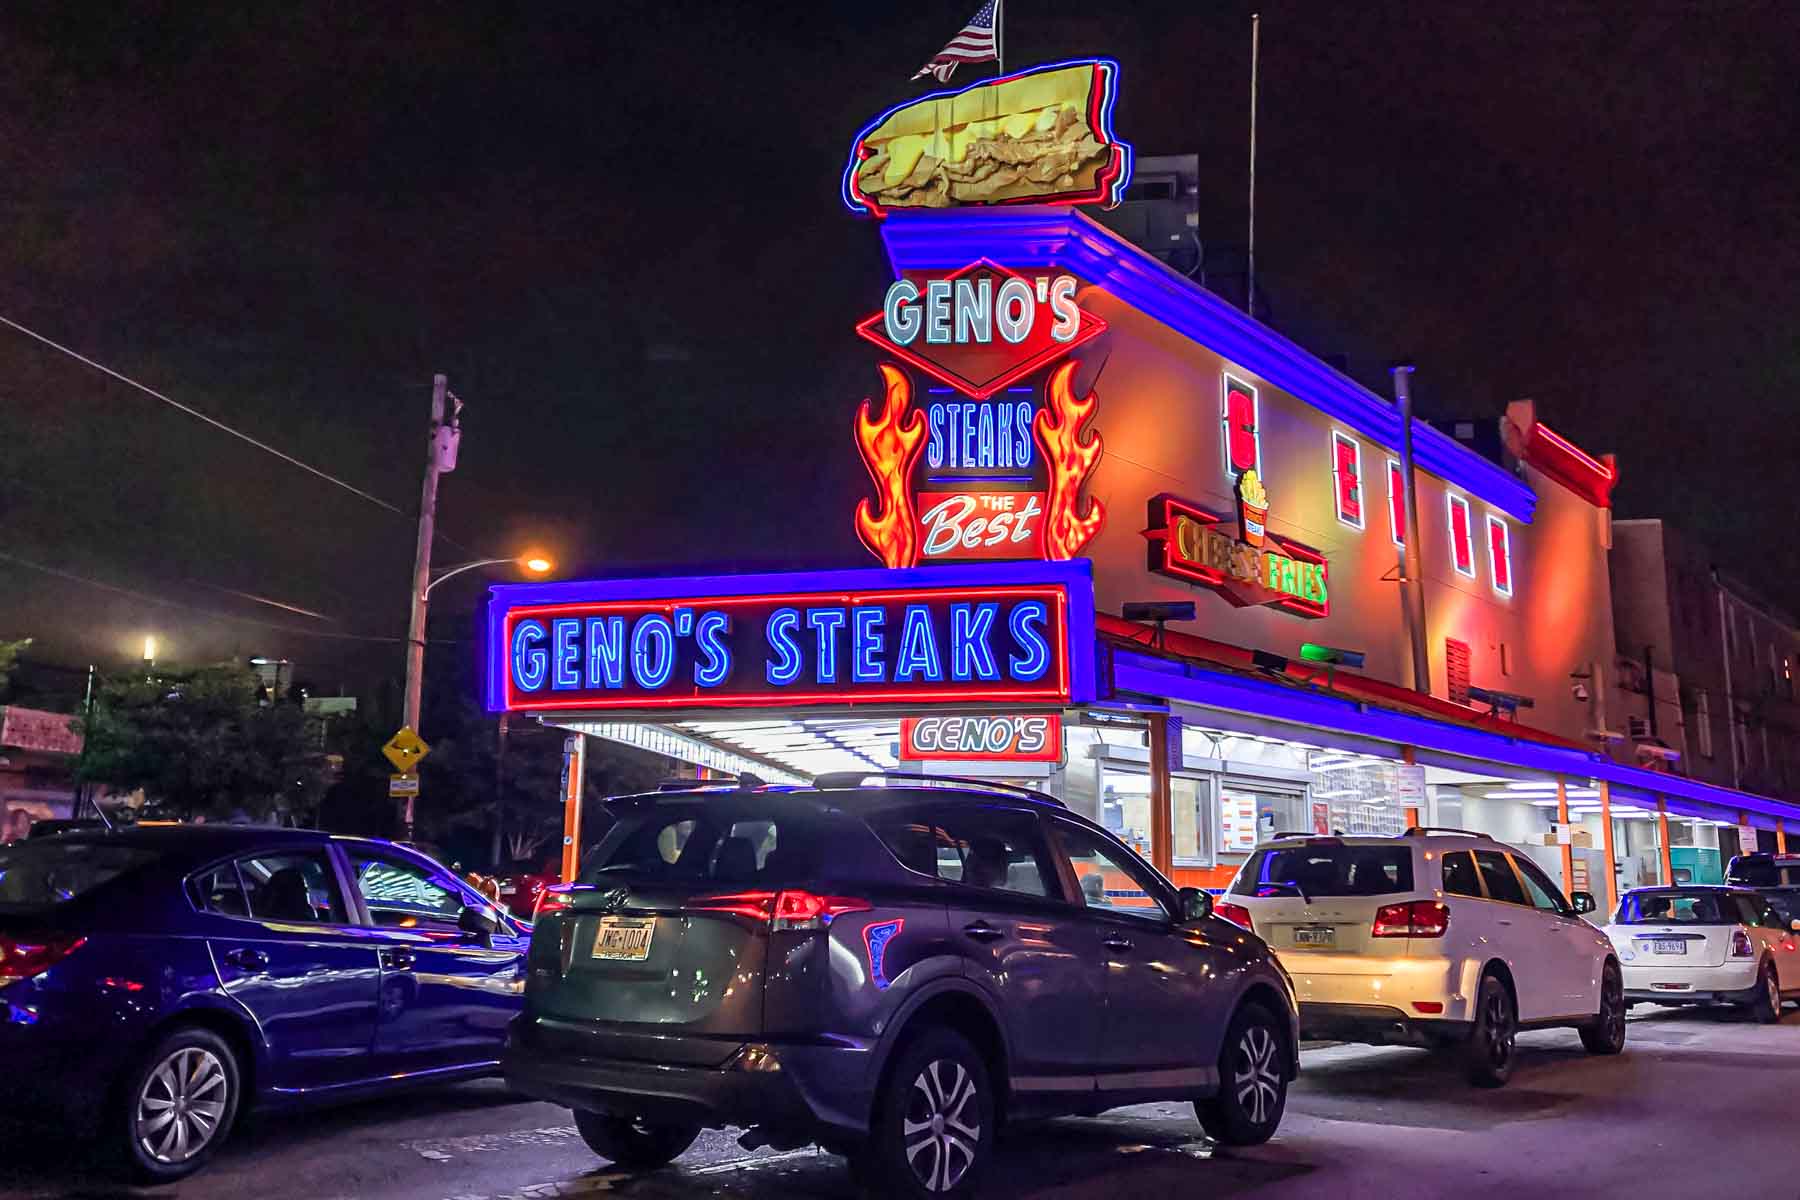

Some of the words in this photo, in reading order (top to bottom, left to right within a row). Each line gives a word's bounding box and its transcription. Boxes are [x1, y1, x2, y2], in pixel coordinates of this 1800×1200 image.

[884, 275, 1080, 346] GENO'S
[928, 402, 1032, 469] STEAKS
[922, 495, 1041, 557] Best
[980, 495, 1015, 510] THE
[1265, 552, 1328, 605] FRIES
[511, 607, 731, 692] GENO'S
[765, 602, 1050, 686] STEAKS
[912, 716, 1048, 755] GENO'S
